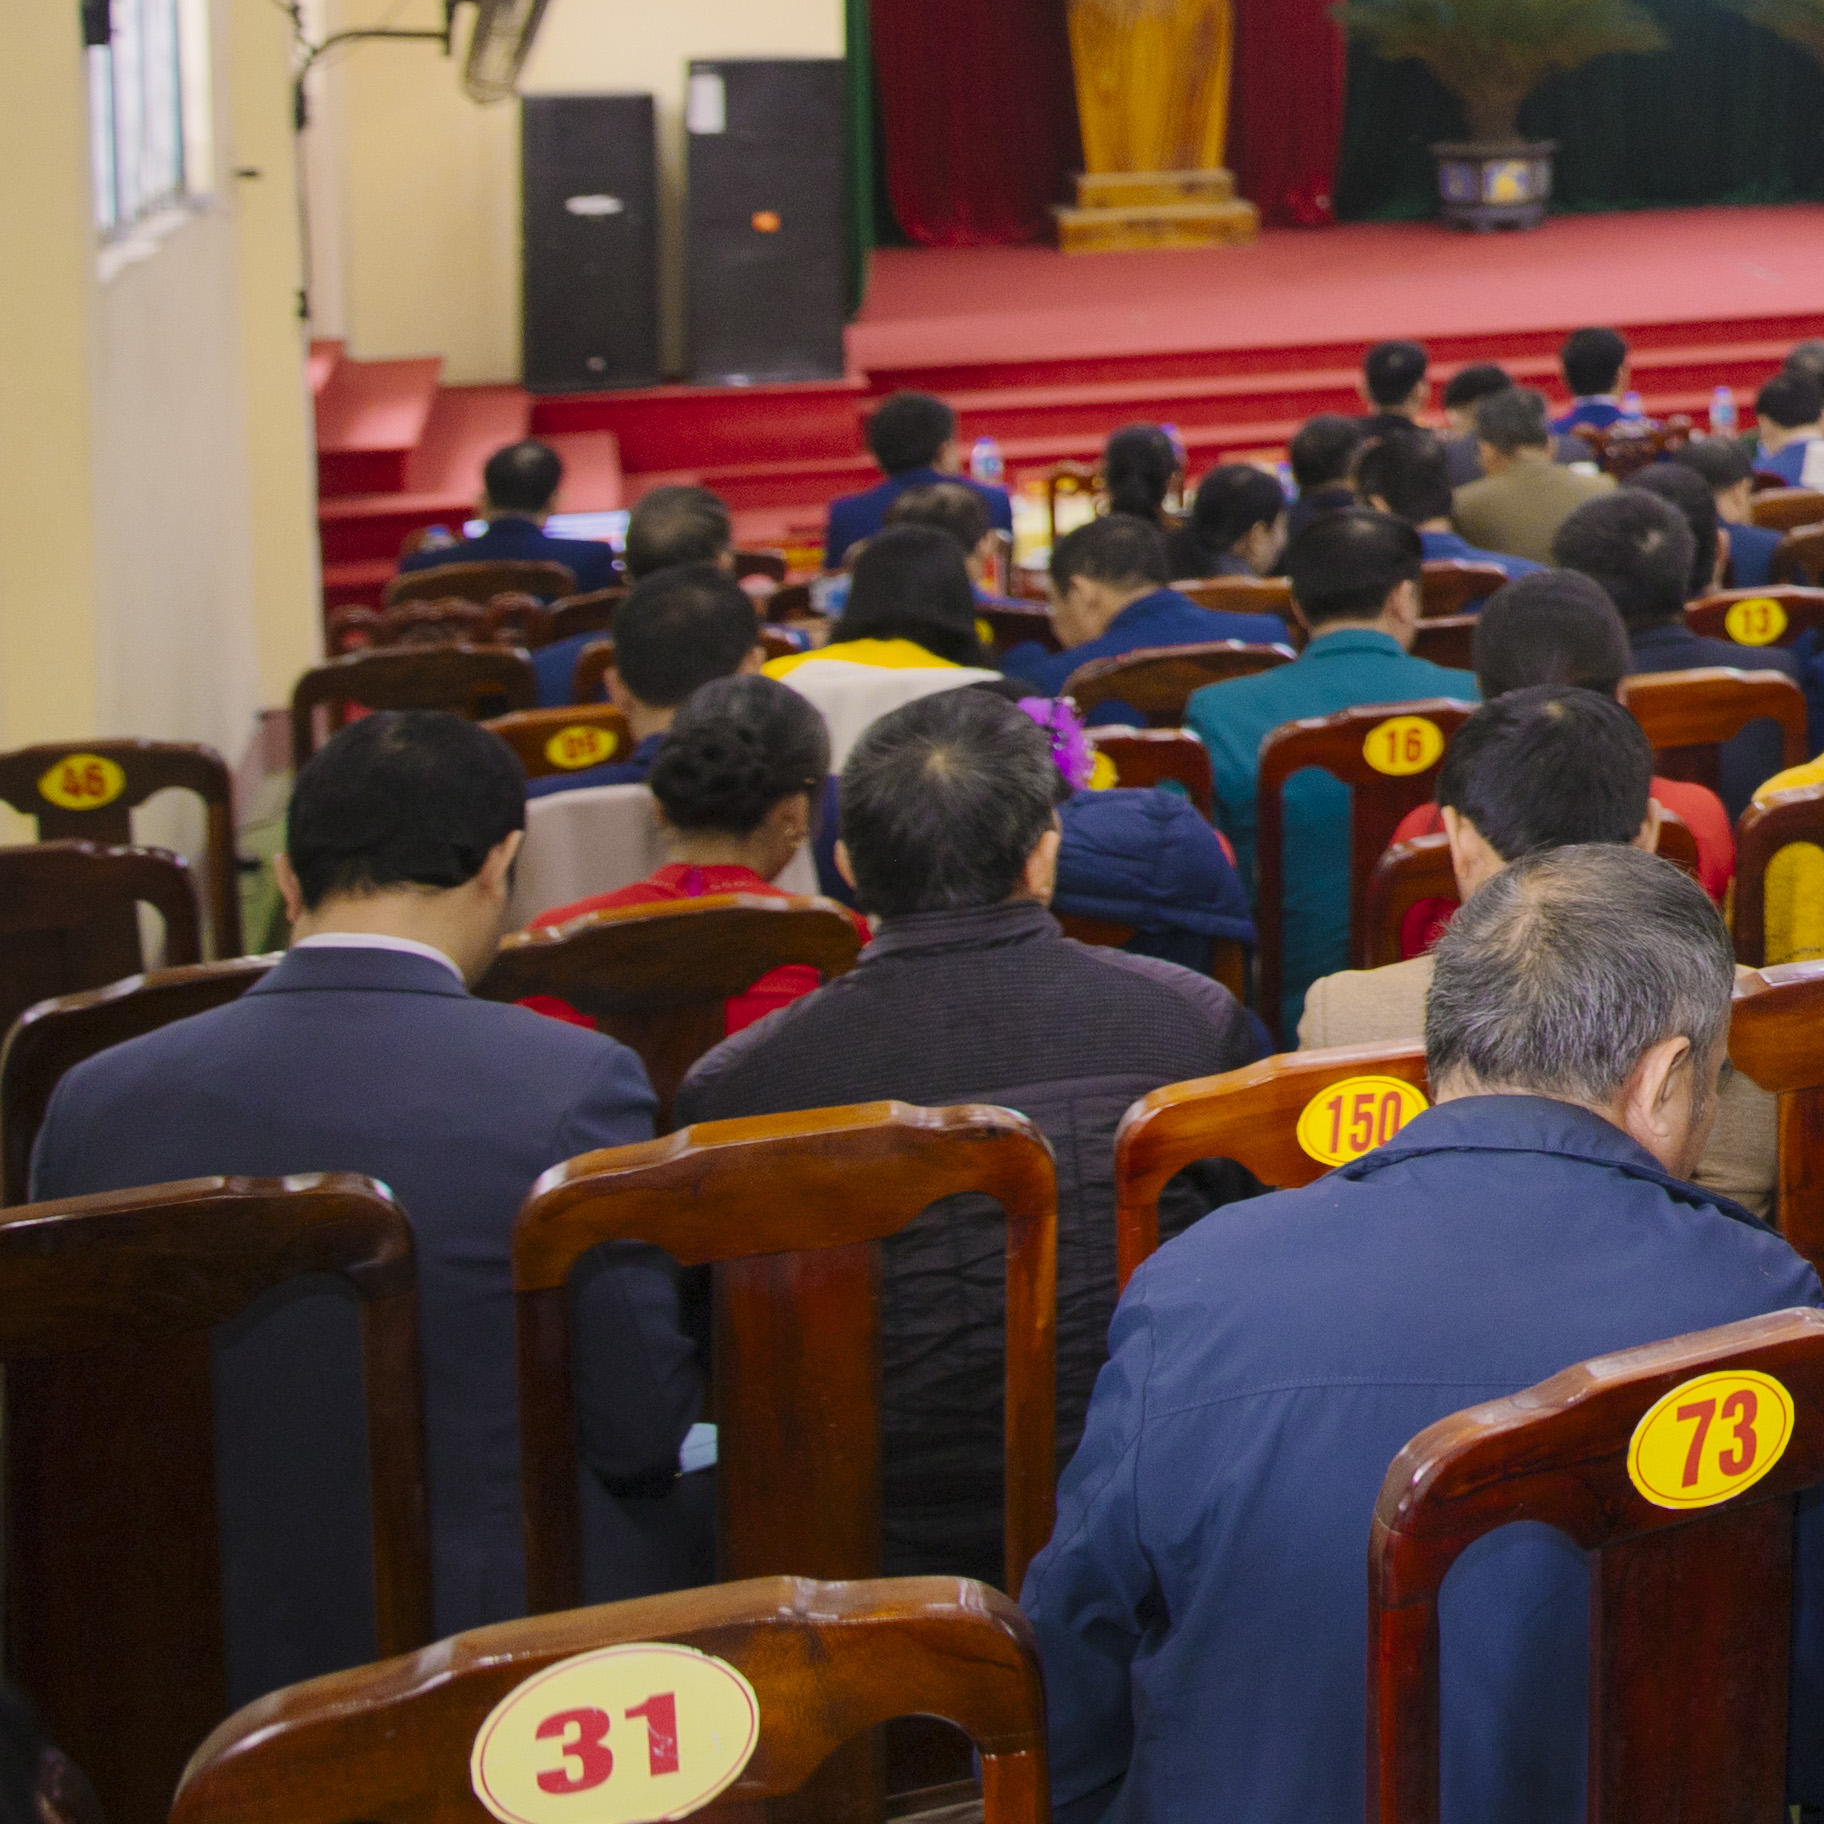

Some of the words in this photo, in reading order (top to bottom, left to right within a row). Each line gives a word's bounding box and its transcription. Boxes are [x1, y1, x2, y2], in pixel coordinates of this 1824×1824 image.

[1743, 605, 1772, 640] 13
[1387, 728, 1422, 762] 16
[1327, 1090, 1402, 1153] 150
[1677, 1389, 1758, 1487] 73
[534, 1690, 680, 1796] 31
